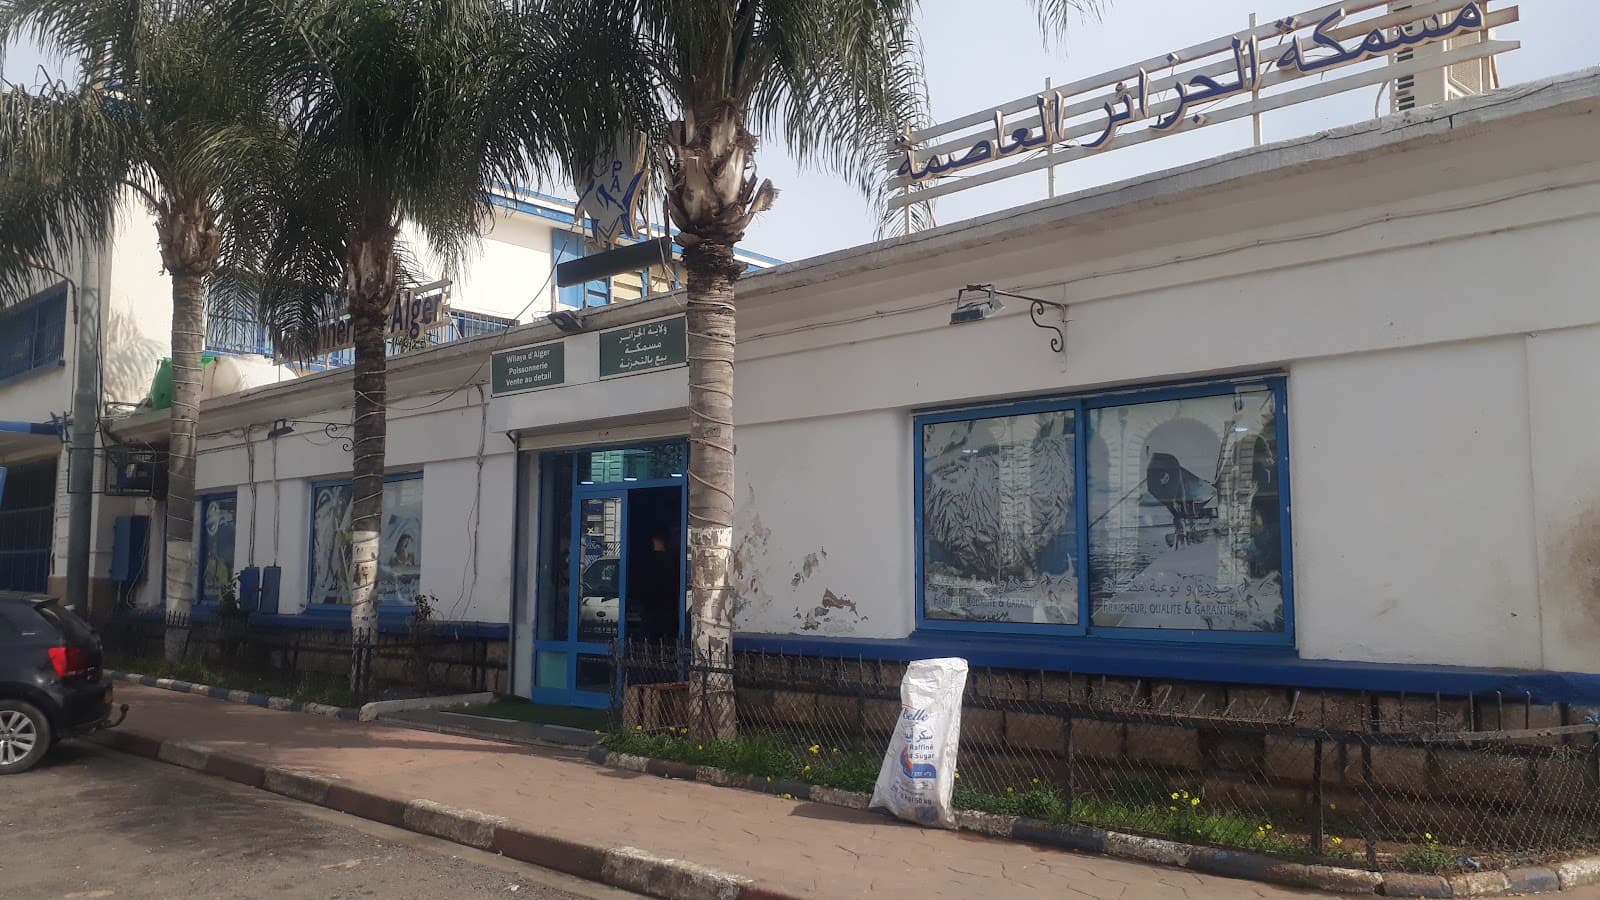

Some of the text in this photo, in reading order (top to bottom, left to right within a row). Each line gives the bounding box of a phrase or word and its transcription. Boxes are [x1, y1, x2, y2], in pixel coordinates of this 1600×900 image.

[895, 1, 1485, 181] مسمكة الجزائر العاصمة
[391, 291, 445, 340] Alger
[618, 323, 668, 344] ولاية الجزائر
[624, 341, 662, 354] مسمكة
[506, 349, 551, 364] Wilaya d'Alger
[654, 354, 668, 366] بيع
[508, 361, 549, 375] Poissonnerie
[506, 377, 524, 387] Vente
[524, 376, 533, 384] au
[1184, 601, 1193, 615] &
[1194, 603, 1236, 616] GARANTIE
[914, 752, 935, 760] Sugar
